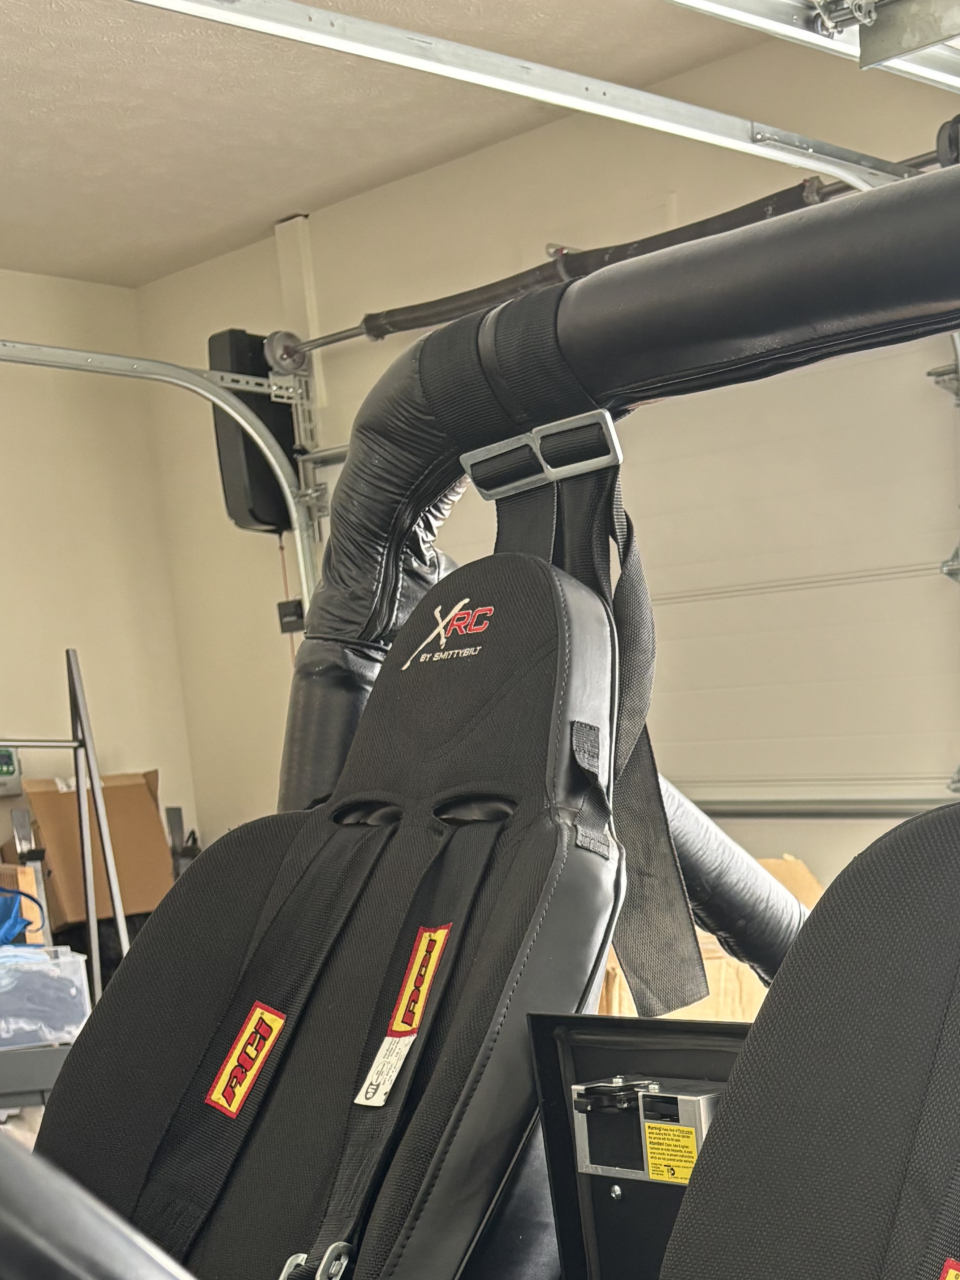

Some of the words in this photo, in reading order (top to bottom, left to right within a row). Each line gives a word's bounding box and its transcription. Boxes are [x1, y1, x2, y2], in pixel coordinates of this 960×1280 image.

[401, 598, 494, 671] XRC
[420, 653, 432, 662] BY
[433, 646, 482, 661] SMITTYBILT
